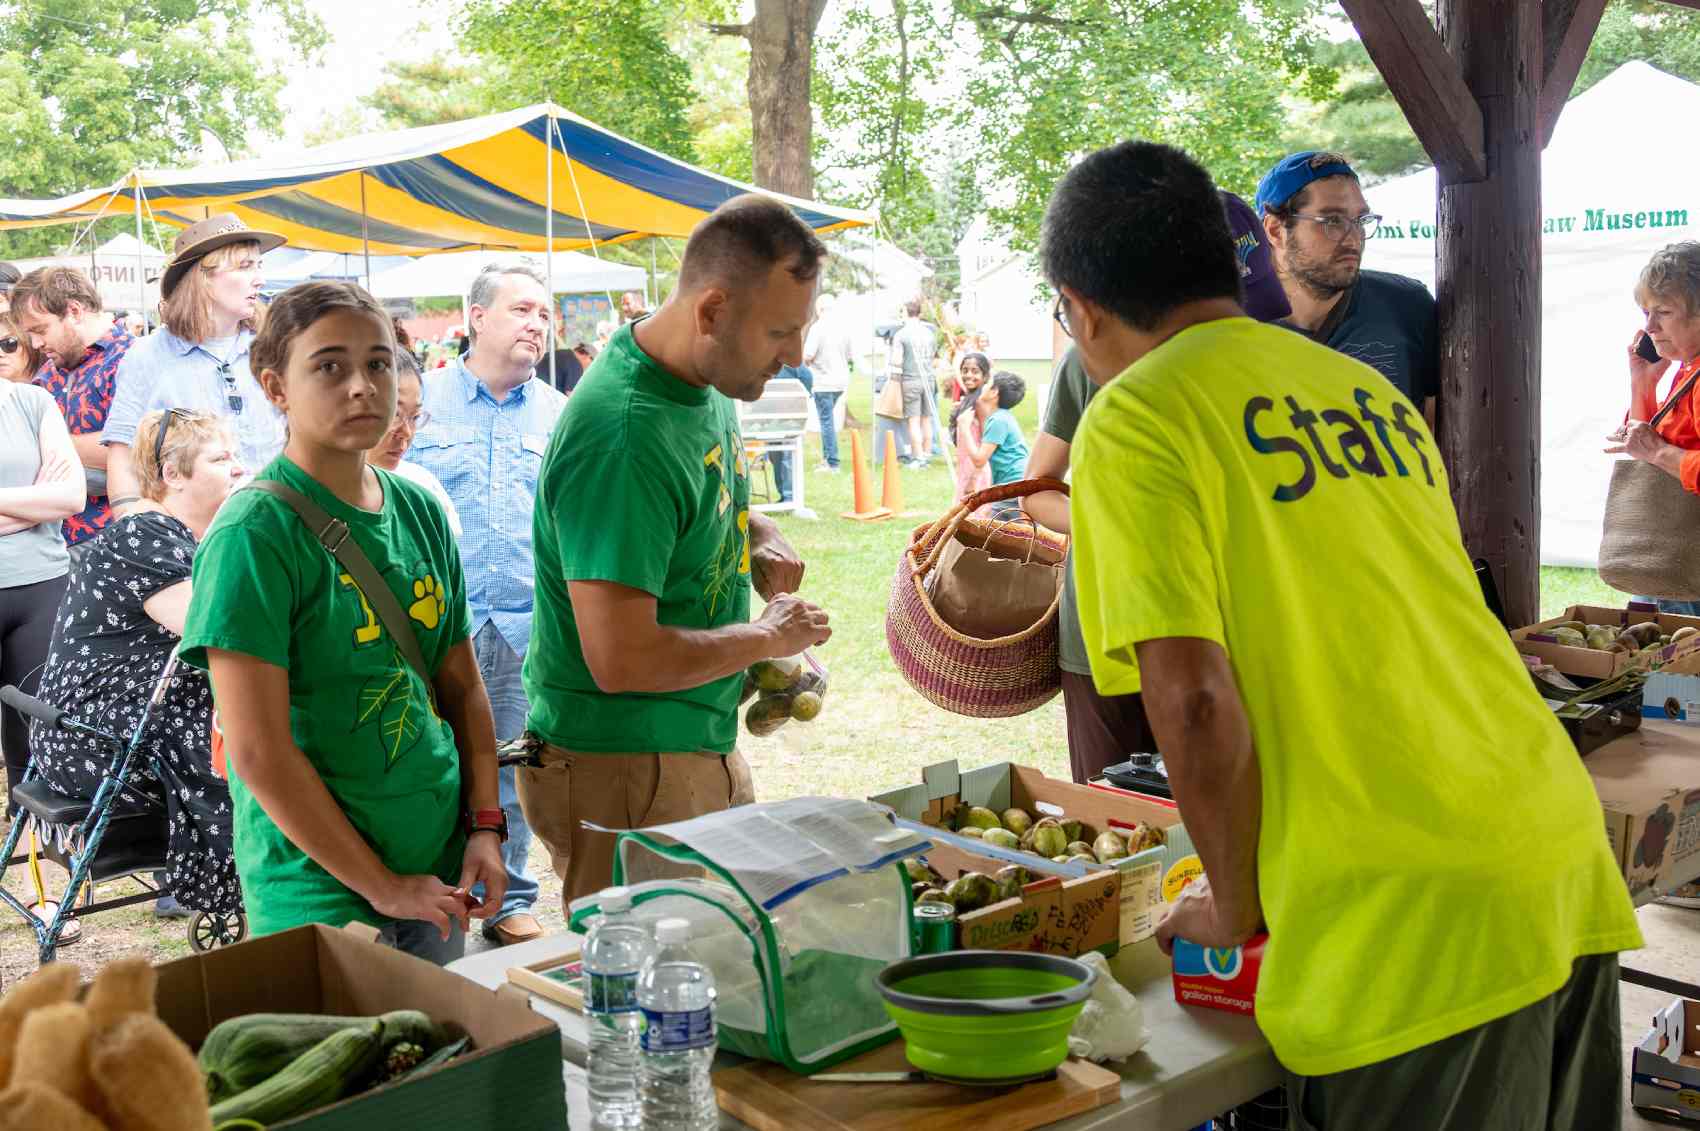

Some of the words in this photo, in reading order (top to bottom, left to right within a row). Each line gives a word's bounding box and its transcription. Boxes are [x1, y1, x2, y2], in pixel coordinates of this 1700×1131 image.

[1543, 216, 1577, 234] aw
[1583, 208, 1689, 232] Museum
[1244, 387, 1436, 503] Staff
[1181, 989, 1213, 1002] gallon
